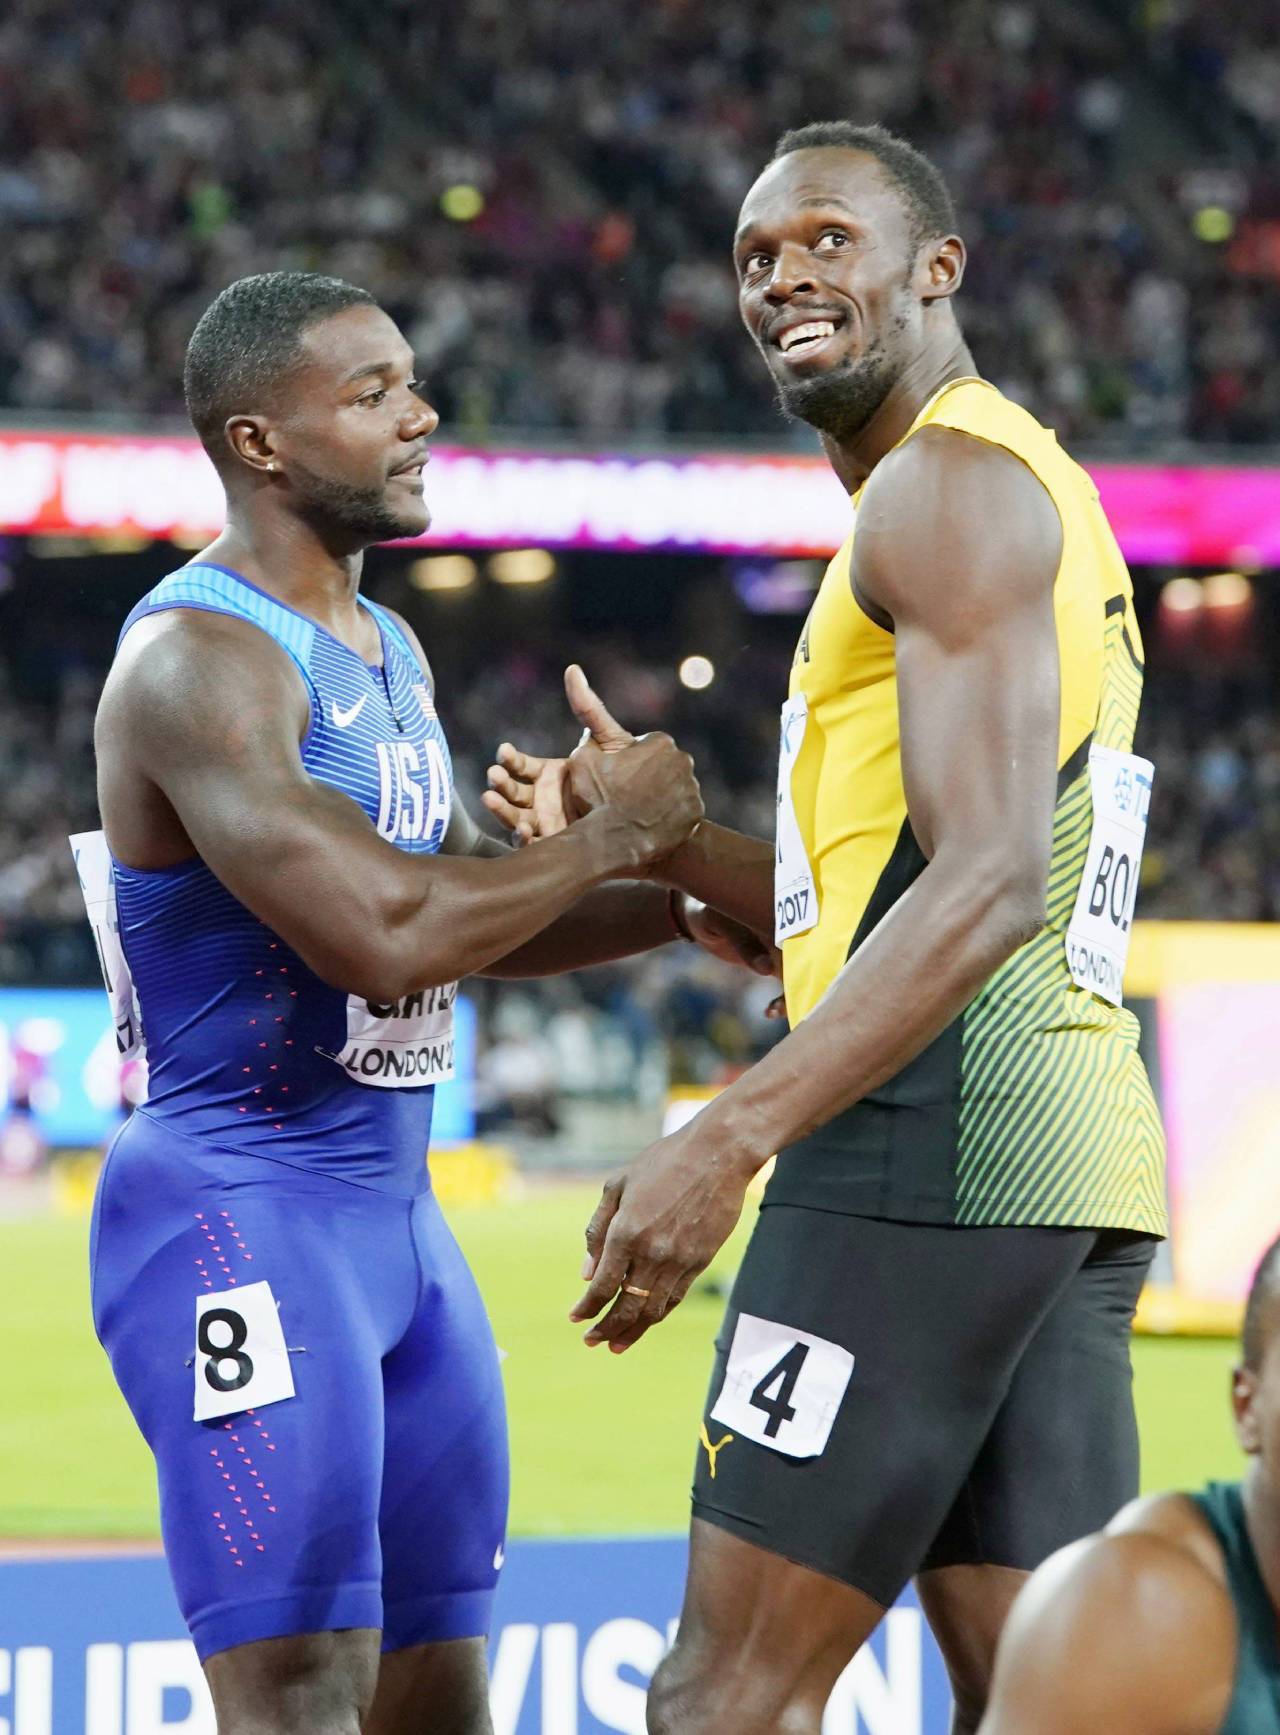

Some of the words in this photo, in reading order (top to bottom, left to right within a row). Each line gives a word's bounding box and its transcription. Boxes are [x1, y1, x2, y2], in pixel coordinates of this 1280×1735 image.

[376, 739, 451, 843] USA
[777, 888, 809, 930] 2017
[345, 1046, 445, 1078] LONDON
[198, 1308, 254, 1392] 8
[749, 1341, 810, 1438] 4
